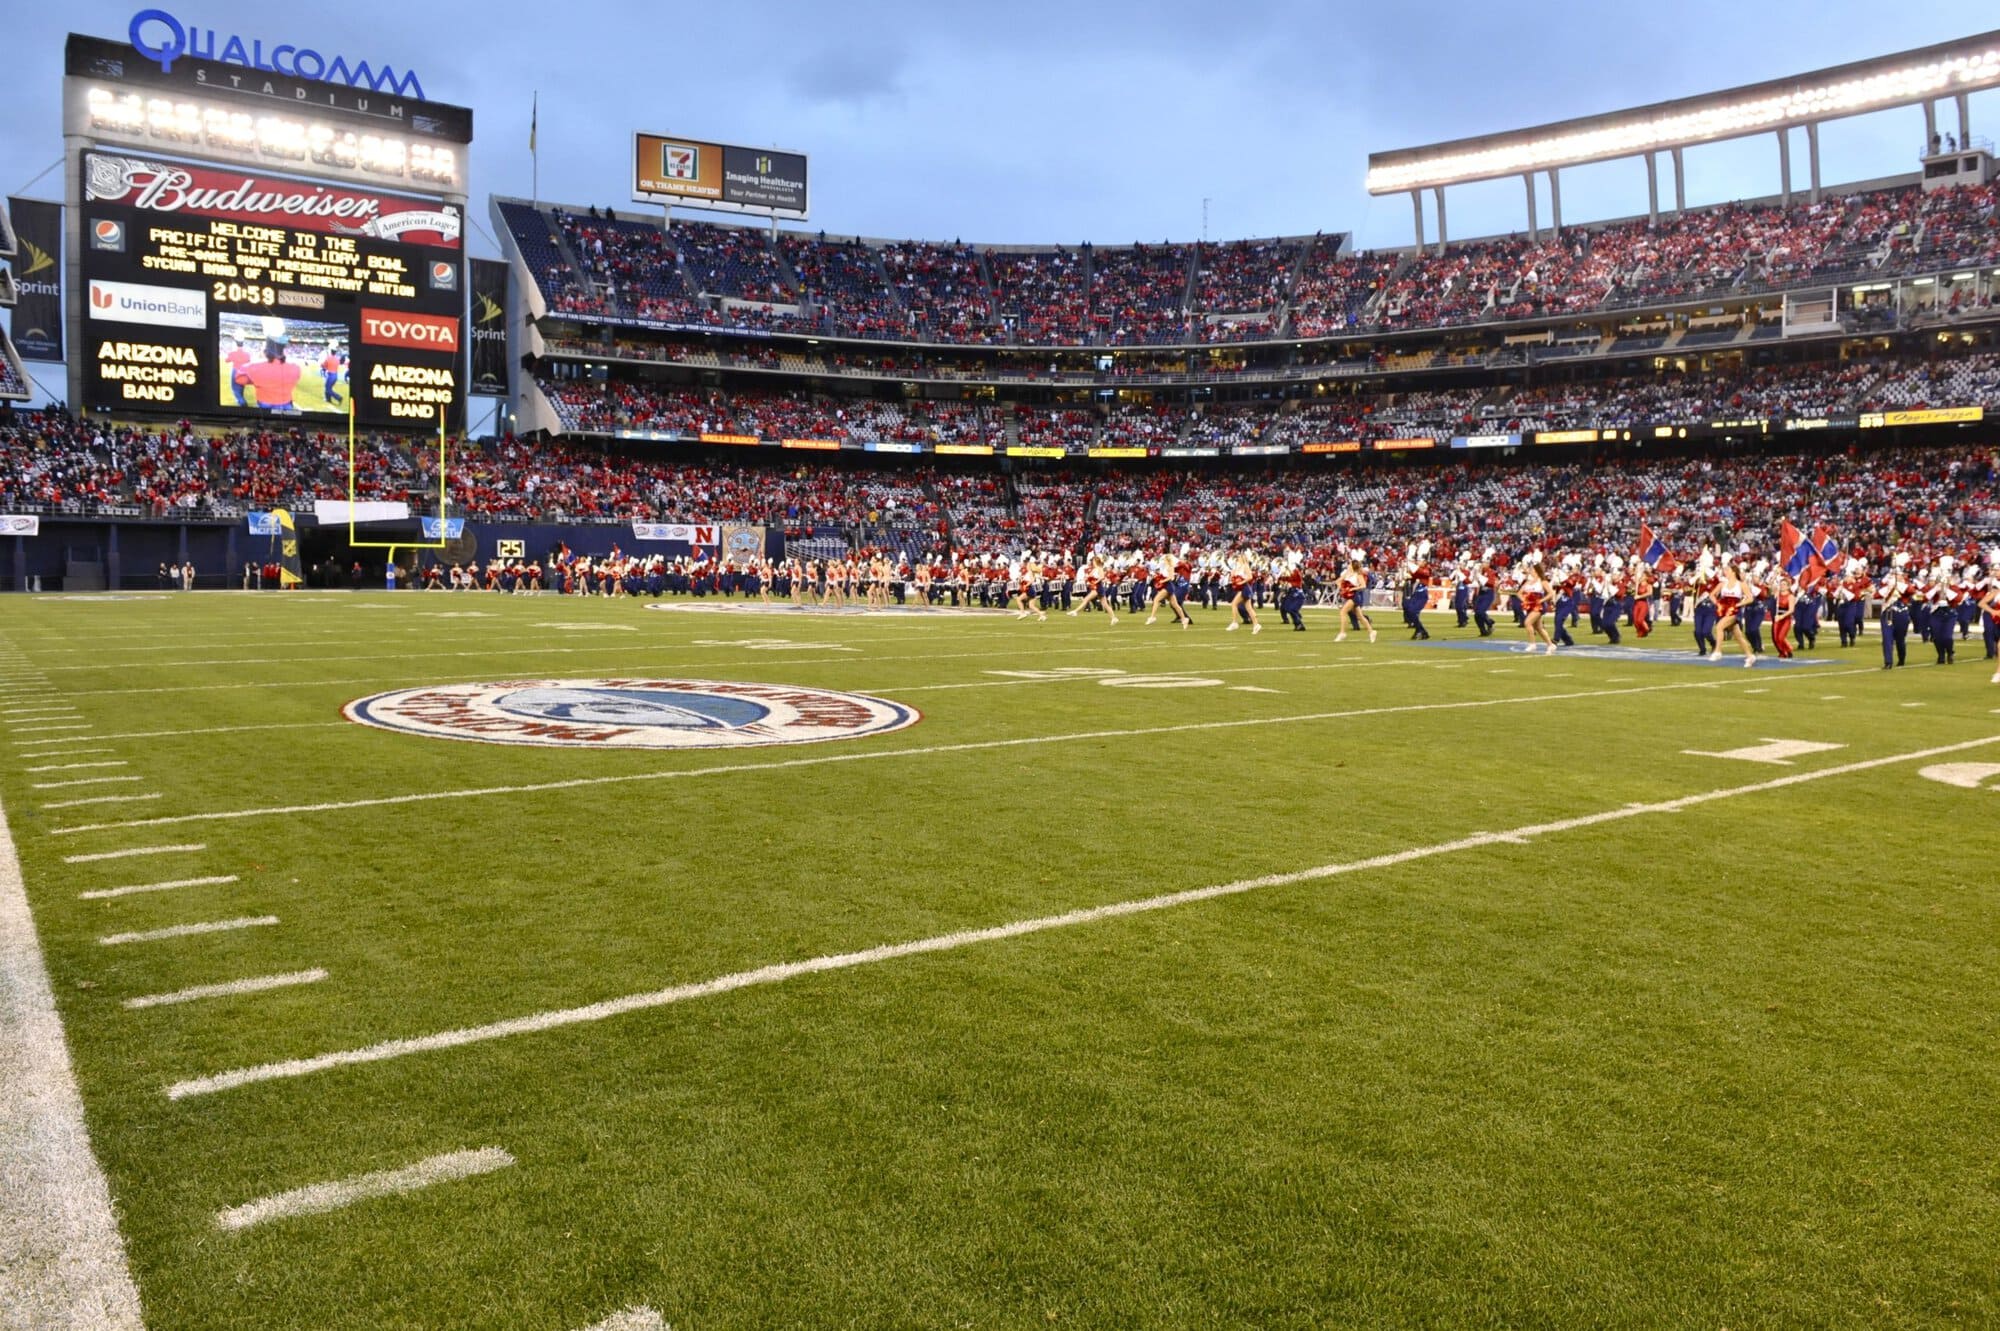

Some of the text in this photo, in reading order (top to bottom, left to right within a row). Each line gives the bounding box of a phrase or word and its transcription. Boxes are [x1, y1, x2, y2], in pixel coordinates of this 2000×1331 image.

[129, 9, 425, 100] QUALCOMM
[196, 69, 403, 117] STADIUM
[726, 171, 803, 189] Imaging Healthcare
[123, 171, 379, 218] Budweiser
[382, 217, 457, 233] American Lager
[211, 221, 356, 252] WELCOME TO THE
[149, 228, 408, 272] PACIFIC LIFE HOLIDAY BOWL
[160, 245, 400, 283] PRE-GAME SHOW PRESENTED BY THE
[202, 262, 238, 277] BAND
[243, 267, 261, 279] OF
[269, 270, 294, 283] THE
[13, 278, 59, 296] Sprint
[121, 297, 203, 316] UnionBank
[366, 319, 454, 344] TOYOTA
[471, 326, 507, 341] Sprint
[98, 341, 199, 366] ARIZONA
[101, 363, 196, 385] MARCHING
[370, 364, 455, 387] ARIZONA
[123, 383, 175, 401] BAND
[372, 384, 452, 403] MARCHING
[391, 402, 434, 418] BAND
[701, 434, 730, 444] WELLS
[1303, 444, 1331, 452] WELLS
[695, 527, 713, 543] N
[501, 541, 521, 557] 25
[397, 708, 642, 741] PACIFIC
